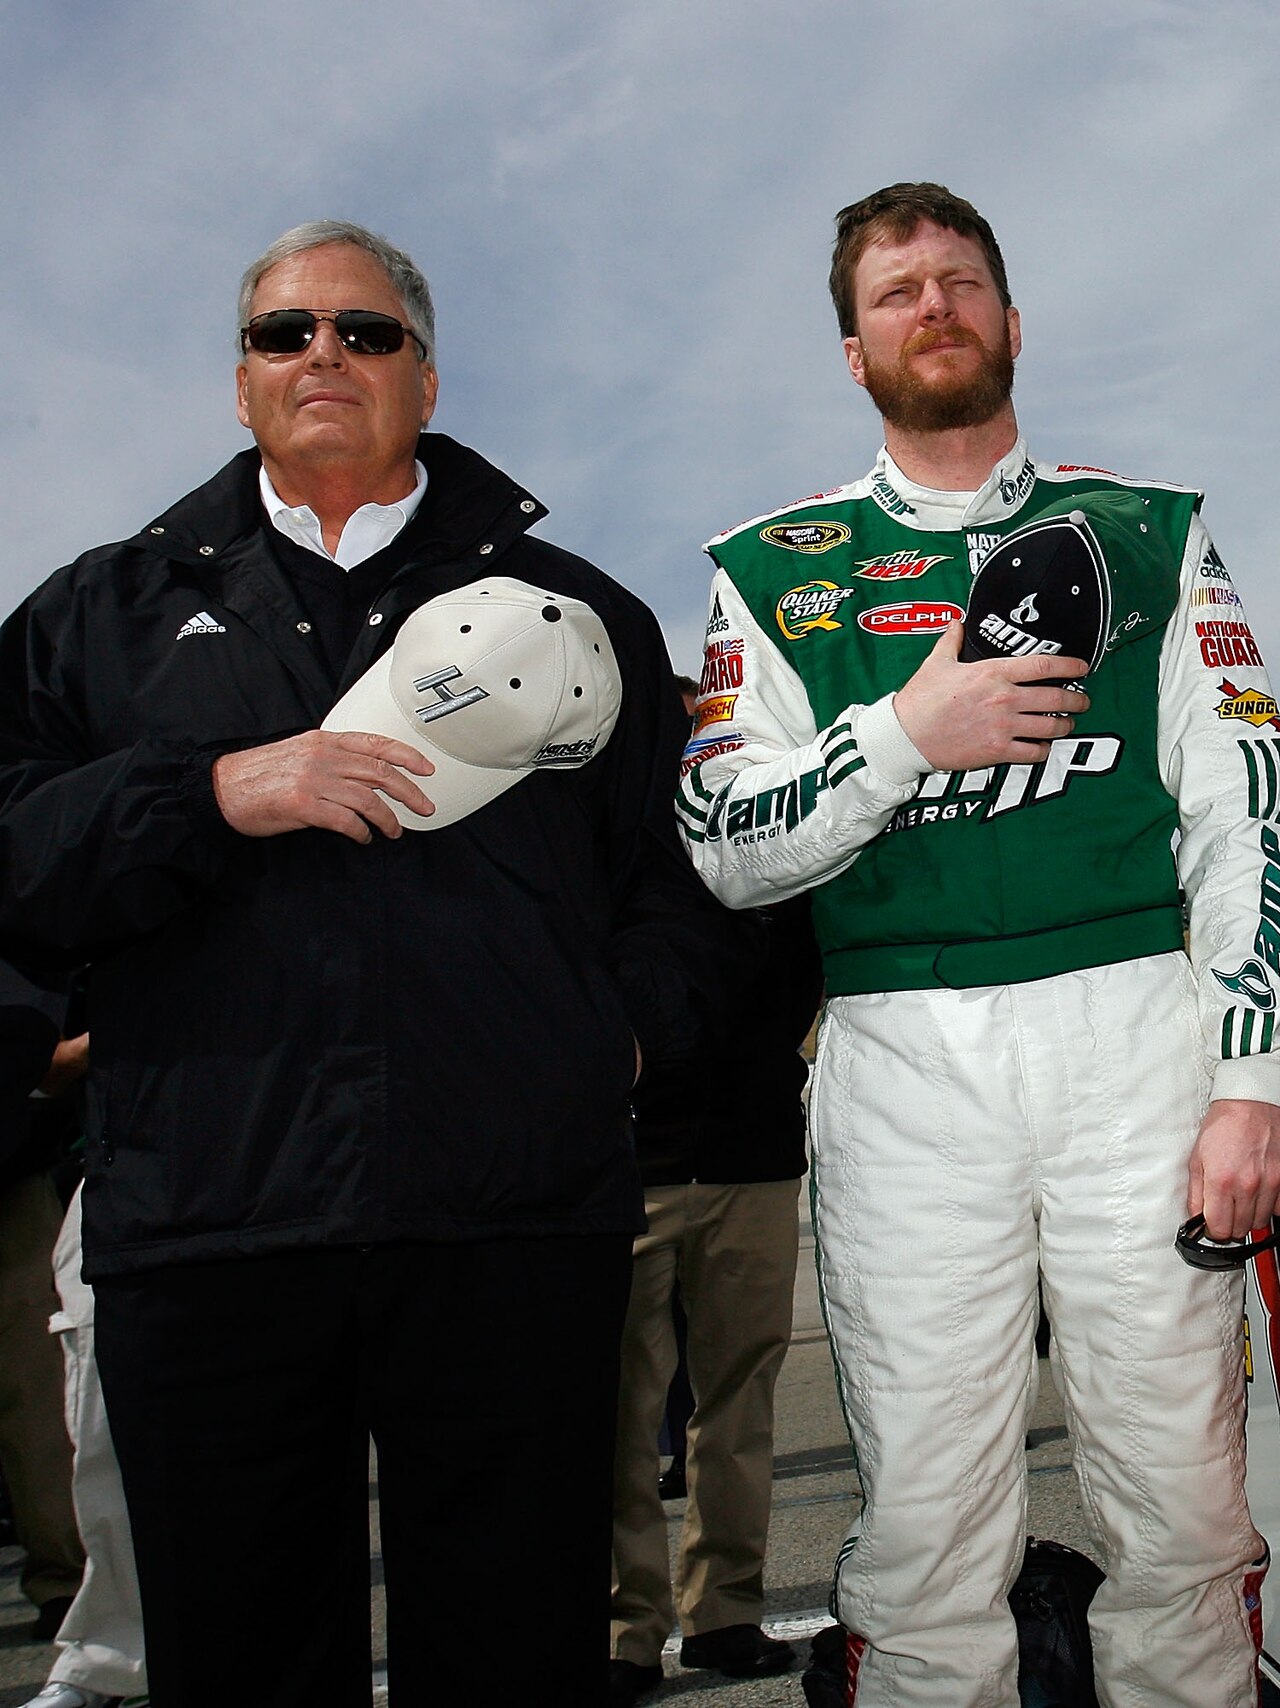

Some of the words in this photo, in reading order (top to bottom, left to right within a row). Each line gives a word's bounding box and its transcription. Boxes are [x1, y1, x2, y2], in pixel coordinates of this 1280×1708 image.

[792, 534, 821, 544] Sprint
[781, 588, 855, 610] QUAKER
[789, 599, 841, 620] STATE
[870, 610, 952, 626] DELPHI
[176, 624, 227, 641] adidas
[1222, 701, 1280, 716] SUNOC
[733, 824, 783, 847] ENERGY
